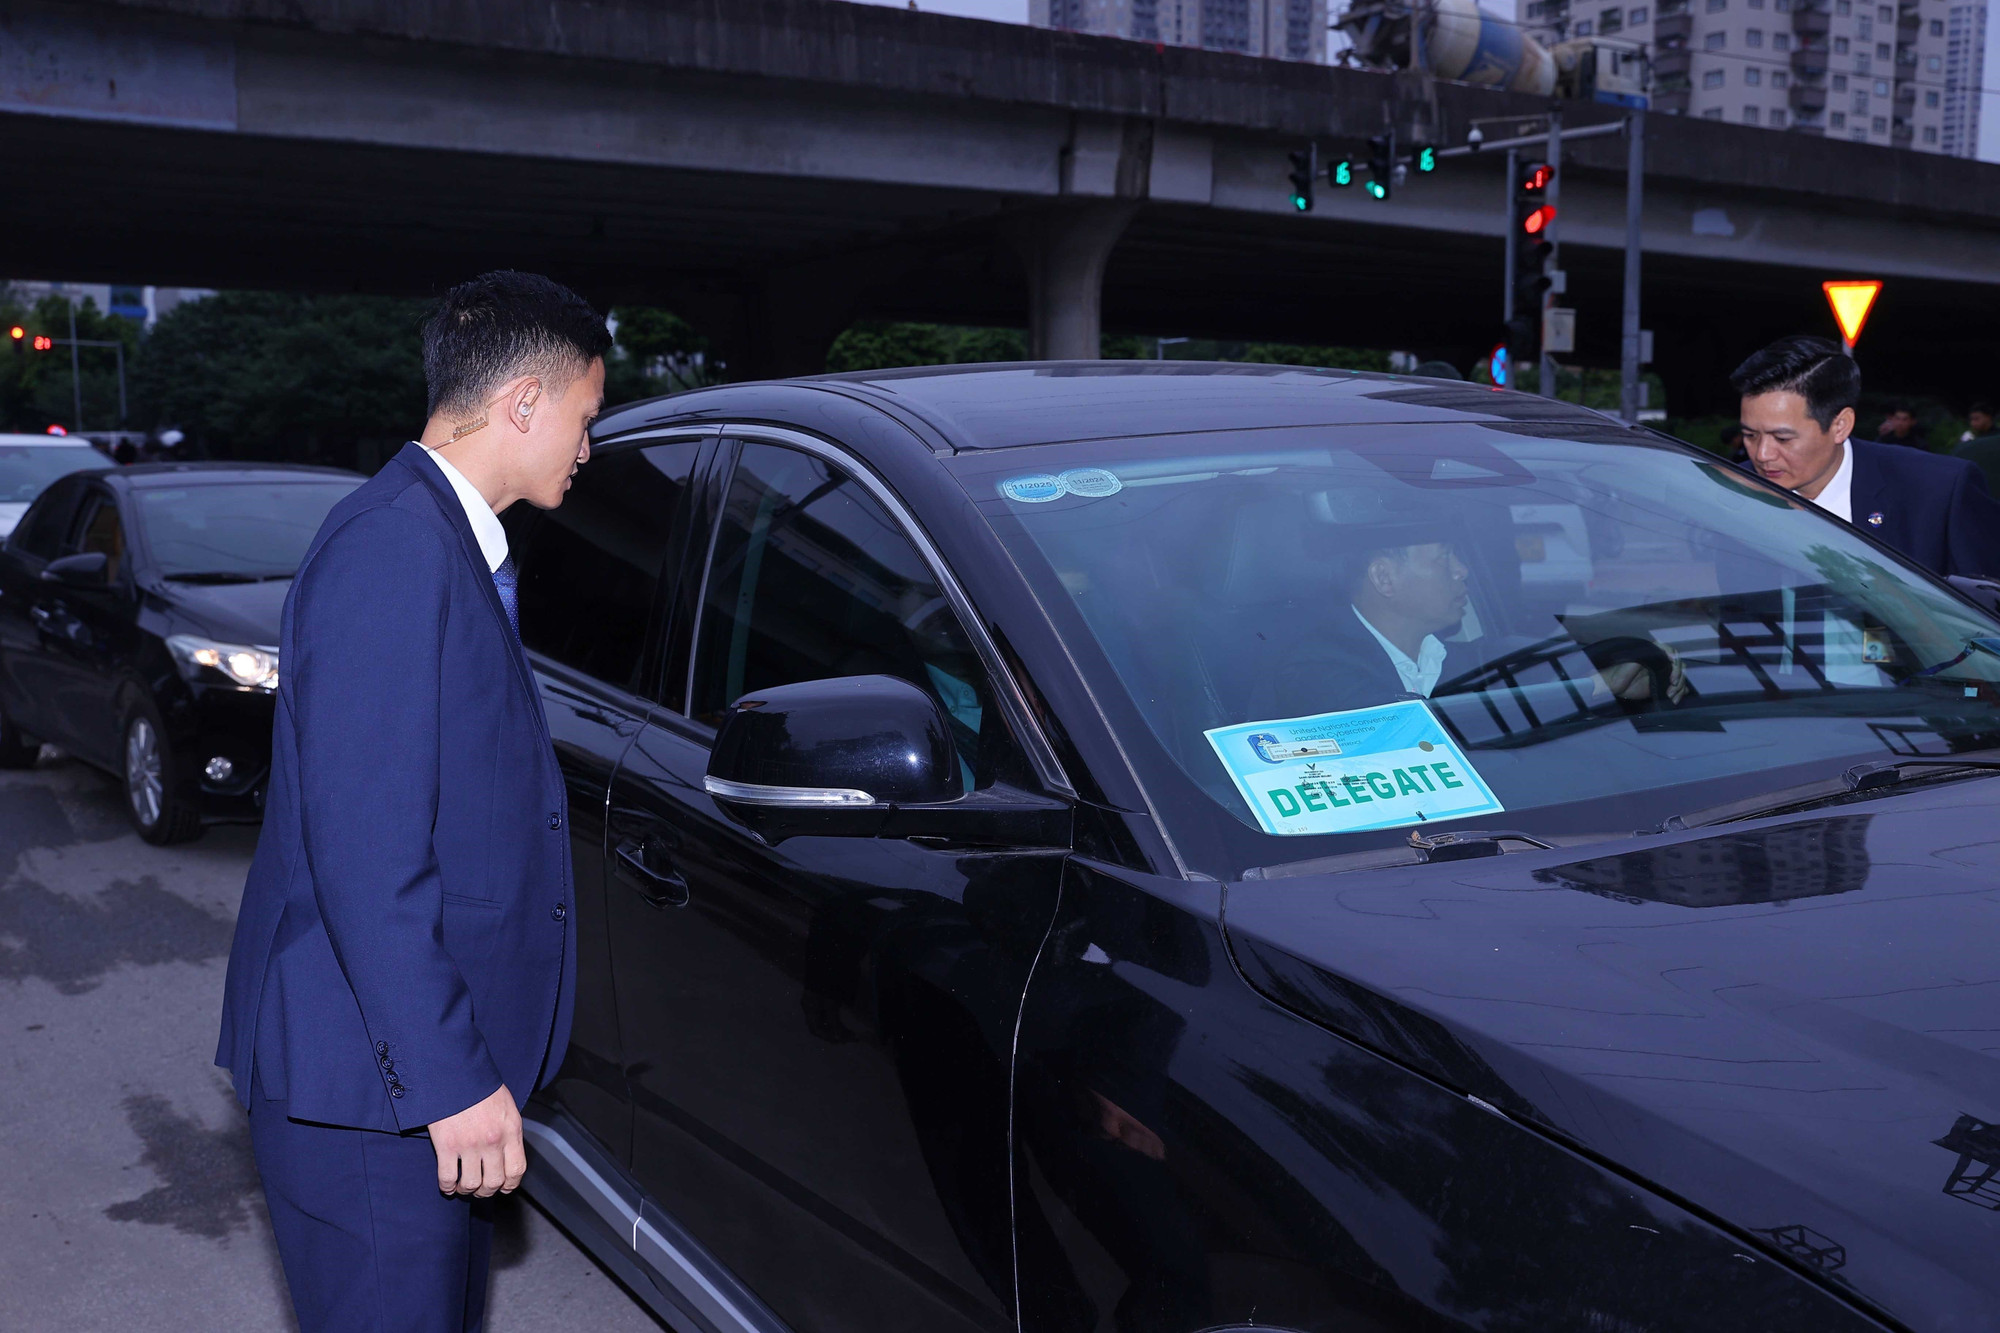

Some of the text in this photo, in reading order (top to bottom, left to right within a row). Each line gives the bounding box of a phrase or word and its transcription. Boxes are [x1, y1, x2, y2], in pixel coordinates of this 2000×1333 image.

[1012, 481, 1053, 490] 11/2025
[1289, 713, 1400, 736] United Nations Convention
[1295, 733, 1326, 742] against
[1327, 725, 1376, 739] Cybercrime
[1267, 761, 1465, 818] DELEGATE
